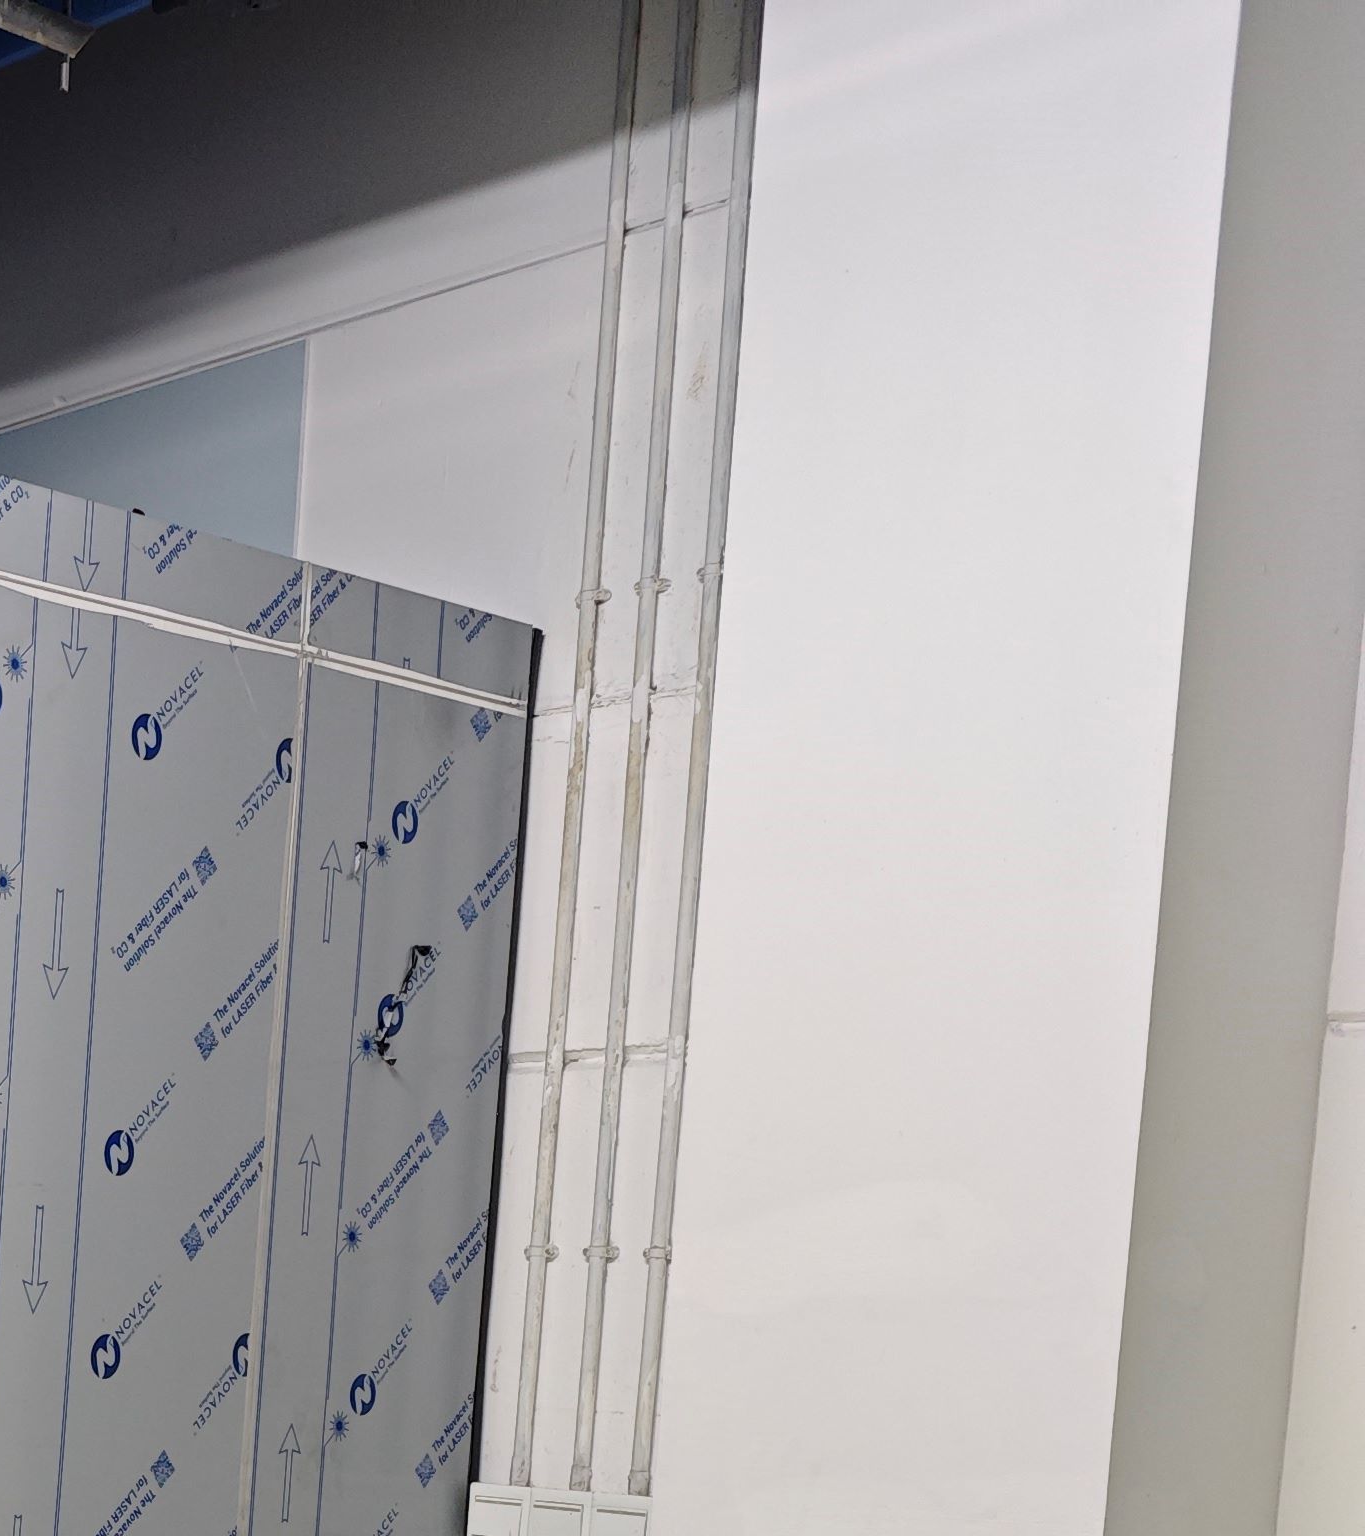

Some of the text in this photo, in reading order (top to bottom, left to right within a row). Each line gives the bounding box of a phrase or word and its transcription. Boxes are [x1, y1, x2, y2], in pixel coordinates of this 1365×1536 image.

[156, 667, 204, 722] NOVACEL
[235, 776, 281, 830] NOVACEL
[413, 756, 454, 808] NOVACEL
[153, 881, 179, 915] LASER
[177, 868, 190, 885] for
[124, 885, 198, 972] The Novacel Solution
[127, 932, 135, 944] &
[135, 910, 155, 936] Fiber
[129, 1079, 176, 1137] NOVACEL
[115, 1281, 162, 1340] NOVACEL
[371, 1324, 413, 1379] NOVACEL
[193, 1371, 238, 1429] NOVACEL
